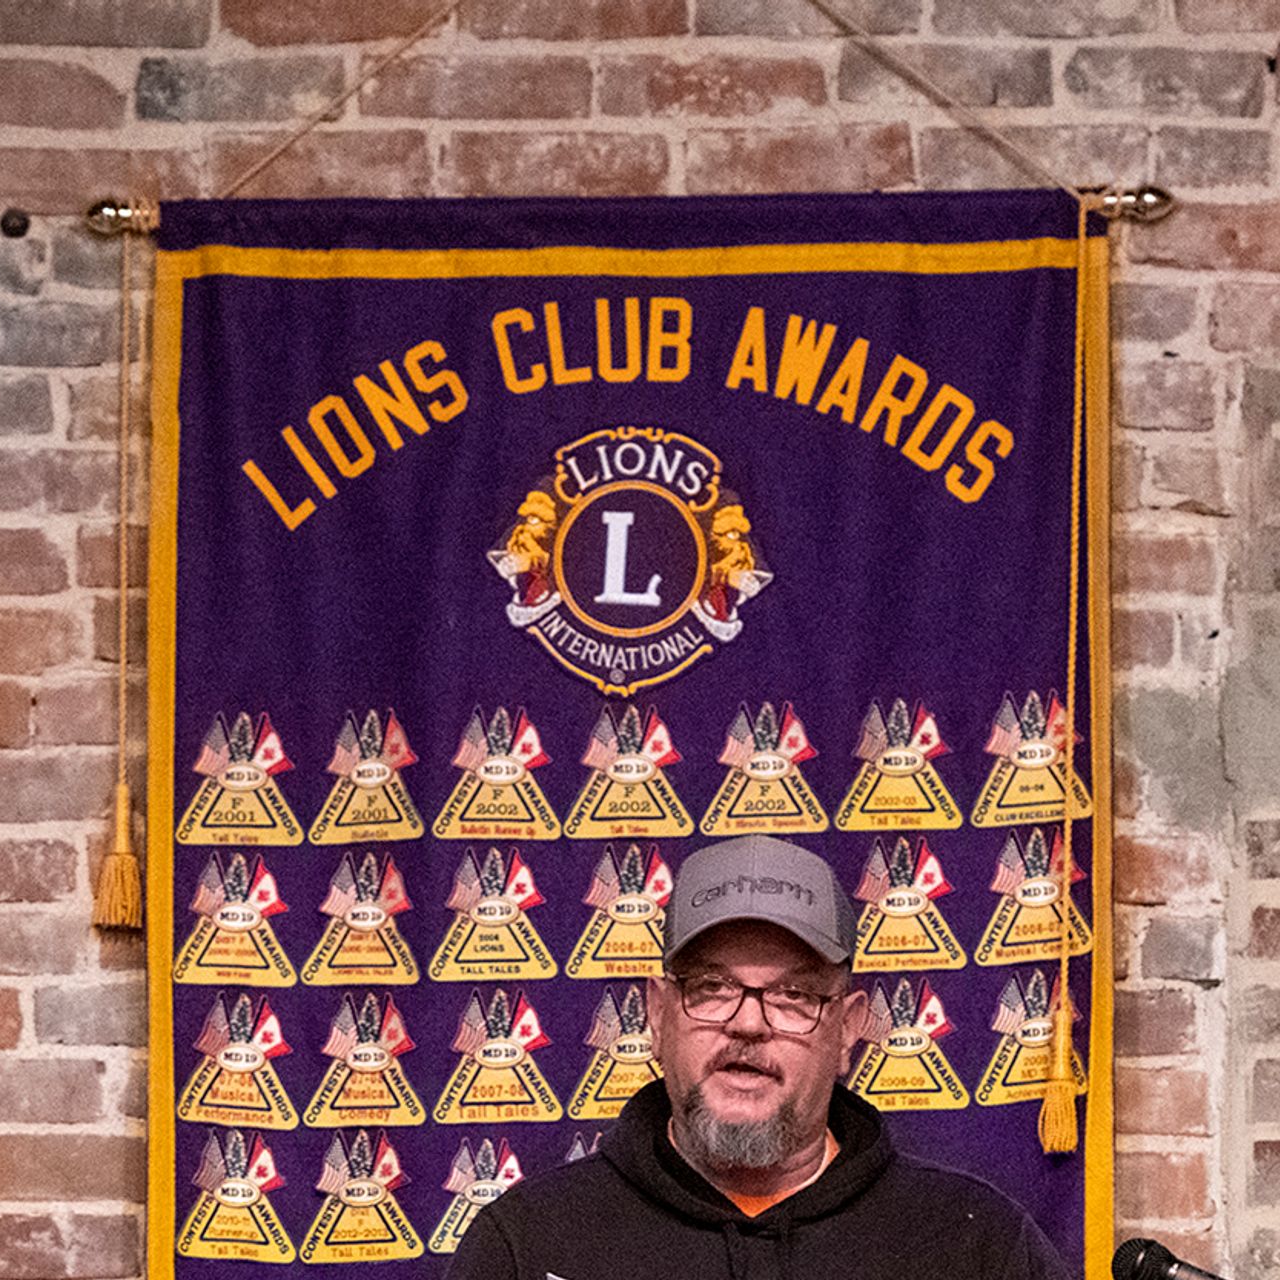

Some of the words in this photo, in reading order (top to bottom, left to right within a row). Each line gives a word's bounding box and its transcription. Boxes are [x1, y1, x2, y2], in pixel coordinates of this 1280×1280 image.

[242, 338, 468, 531] LIONS
[491, 297, 693, 394] CLUB
[725, 306, 1015, 503] AWARDS
[566, 442, 709, 496] LIONS
[593, 511, 663, 606] L
[537, 610, 704, 671] INTERNATIONAL
[225, 772, 244, 780] MD
[248, 772, 259, 780] 19
[356, 769, 374, 778] MD
[484, 766, 502, 774] MD
[506, 766, 518, 774] 19
[614, 765, 632, 773] MD
[635, 764, 648, 773] 19
[750, 762, 769, 771] MD
[773, 760, 784, 770] 19
[883, 757, 902, 766] MD
[905, 756, 917, 766] 19
[1017, 750, 1037, 759] MD
[1040, 748, 1051, 757] 19
[178, 776, 217, 841] CONTESTS
[231, 798, 244, 809] F
[264, 787, 298, 837] AWARDS
[311, 777, 353, 841] CONTESTS
[352, 808, 388, 821] 2001
[436, 773, 476, 835] CONTESTS
[476, 803, 518, 816] 2002
[493, 789, 503, 800] F
[522, 781, 555, 831] AWARDS
[567, 773, 607, 834] CONTESTS
[609, 801, 651, 813] 2002
[625, 787, 635, 797] F
[653, 779, 687, 828] AWARDS
[703, 770, 743, 832] CONTESTS
[744, 799, 786, 812] 2002
[760, 785, 770, 796] F
[790, 775, 823, 823] AWARDS
[922, 771, 956, 820] AWARDS
[214, 811, 255, 822] 2001
[477, 906, 496, 916] MD
[500, 905, 511, 915] 19
[615, 904, 635, 913] MD
[638, 904, 650, 913] 19
[886, 898, 905, 907] MD
[908, 897, 920, 906] 19
[1022, 887, 1041, 897] MD
[1043, 886, 1055, 895] 19
[220, 912, 239, 921] MD
[242, 912, 254, 921] 19
[351, 912, 368, 921] MD
[925, 912, 961, 960] AWARDS
[978, 899, 1015, 962] CONTESTS
[175, 920, 212, 979] CONTESTS
[258, 928, 291, 978] AWARDS
[303, 920, 345, 981] CONTESTS
[384, 927, 414, 975] AWARDS
[431, 916, 469, 977] CONTESTS
[516, 921, 551, 970] AWARDS
[568, 912, 608, 975] CONTESTS
[489, 966, 521, 974] TALES
[224, 1053, 242, 1061] MD
[246, 1054, 258, 1062] 19
[353, 1053, 371, 1062] MD
[374, 1052, 385, 1061] 19
[482, 1049, 502, 1057] MD
[505, 1048, 517, 1057] 19
[616, 1044, 636, 1053] MD
[888, 1038, 908, 1047] MD
[910, 1037, 922, 1046] 19
[1021, 1029, 1041, 1038] MD
[180, 1059, 216, 1117] CONTESTS
[307, 1061, 347, 1124] CONTESTS
[389, 1068, 420, 1117] AWARDS
[436, 1058, 476, 1120] CONTESTS
[522, 1063, 556, 1113] AWARDS
[571, 1052, 609, 1116] CONTESTS
[927, 1051, 963, 1100] AWARDS
[978, 1039, 1013, 1102] CONTESTS
[261, 1070, 292, 1121] AWARDS
[497, 1105, 540, 1117] Tales
[221, 1187, 239, 1197] MD
[241, 1188, 254, 1197] 19
[345, 1188, 365, 1197] MD
[367, 1187, 379, 1196] 19
[471, 1190, 489, 1198] MD
[256, 1203, 290, 1254] AWARDS
[303, 1195, 340, 1260] CONTESTS
[384, 1201, 417, 1249] AWARDS
[432, 1193, 466, 1250] CONTESTS
[331, 1247, 353, 1258] Tall
[359, 1247, 389, 1256] Tales
